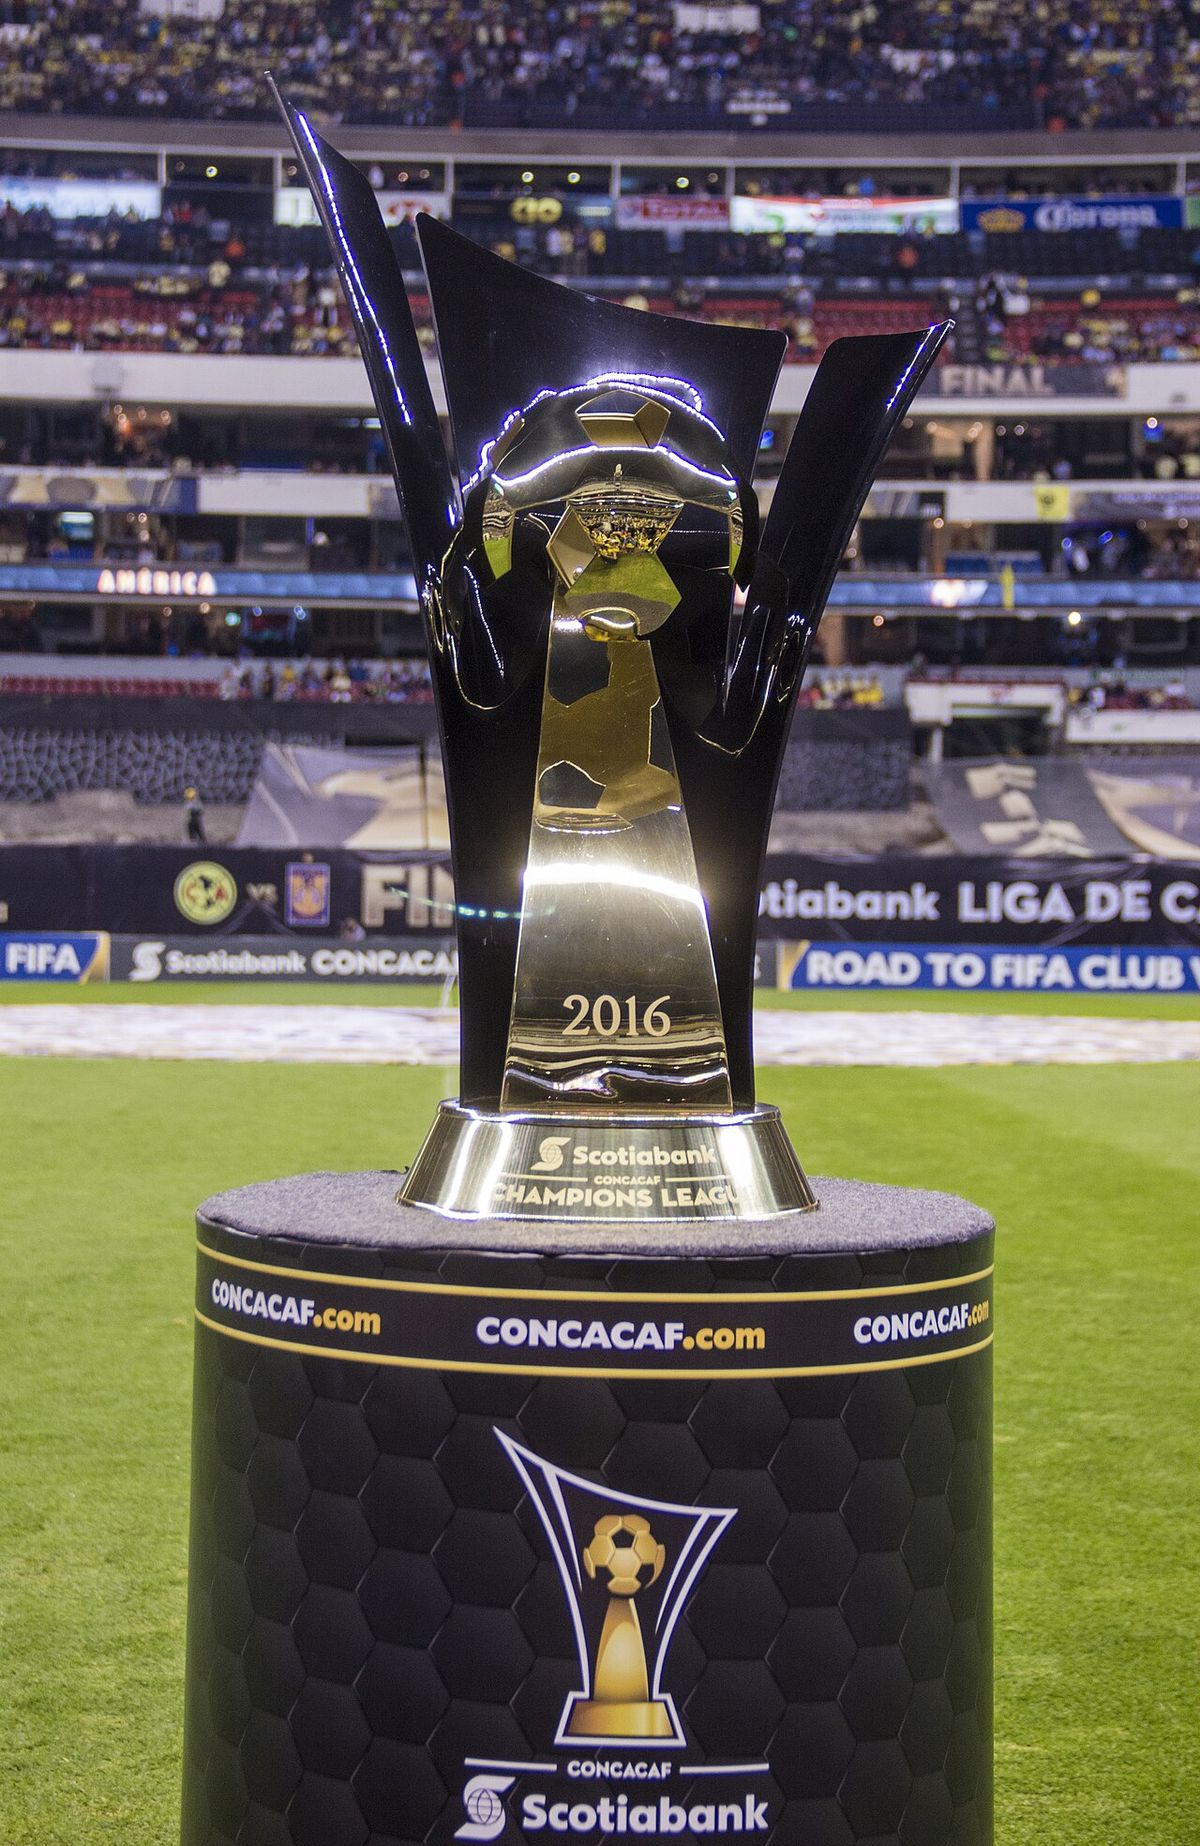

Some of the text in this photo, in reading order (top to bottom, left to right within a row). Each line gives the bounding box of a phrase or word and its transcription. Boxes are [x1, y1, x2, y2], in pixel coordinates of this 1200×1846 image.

[1034, 200, 1160, 232] Corona
[941, 366, 1055, 394] FINAL
[958, 880, 1076, 923] LIGA
[1083, 879, 1152, 922] DE
[1159, 880, 1200, 924] C
[5, 942, 81, 974] FIFA
[165, 949, 306, 974] Scotiabank
[806, 950, 921, 985] ROAD
[924, 952, 986, 987] TO
[991, 953, 1075, 988] FIFA
[1078, 954, 1185, 990] CLUB
[562, 994, 671, 1037] 2016
[572, 1145, 717, 1166] Scotiabank
[593, 1174, 661, 1186] CONCACAF
[660, 1183, 742, 1208] LEAGU
[211, 1278, 381, 1335] CONCACAF.com
[853, 1299, 990, 1344] CONCACAF.com
[475, 1316, 766, 1350] CONCACAF.com
[567, 1760, 672, 1779] CONCACAF
[522, 1794, 769, 1832] Scotiabank
